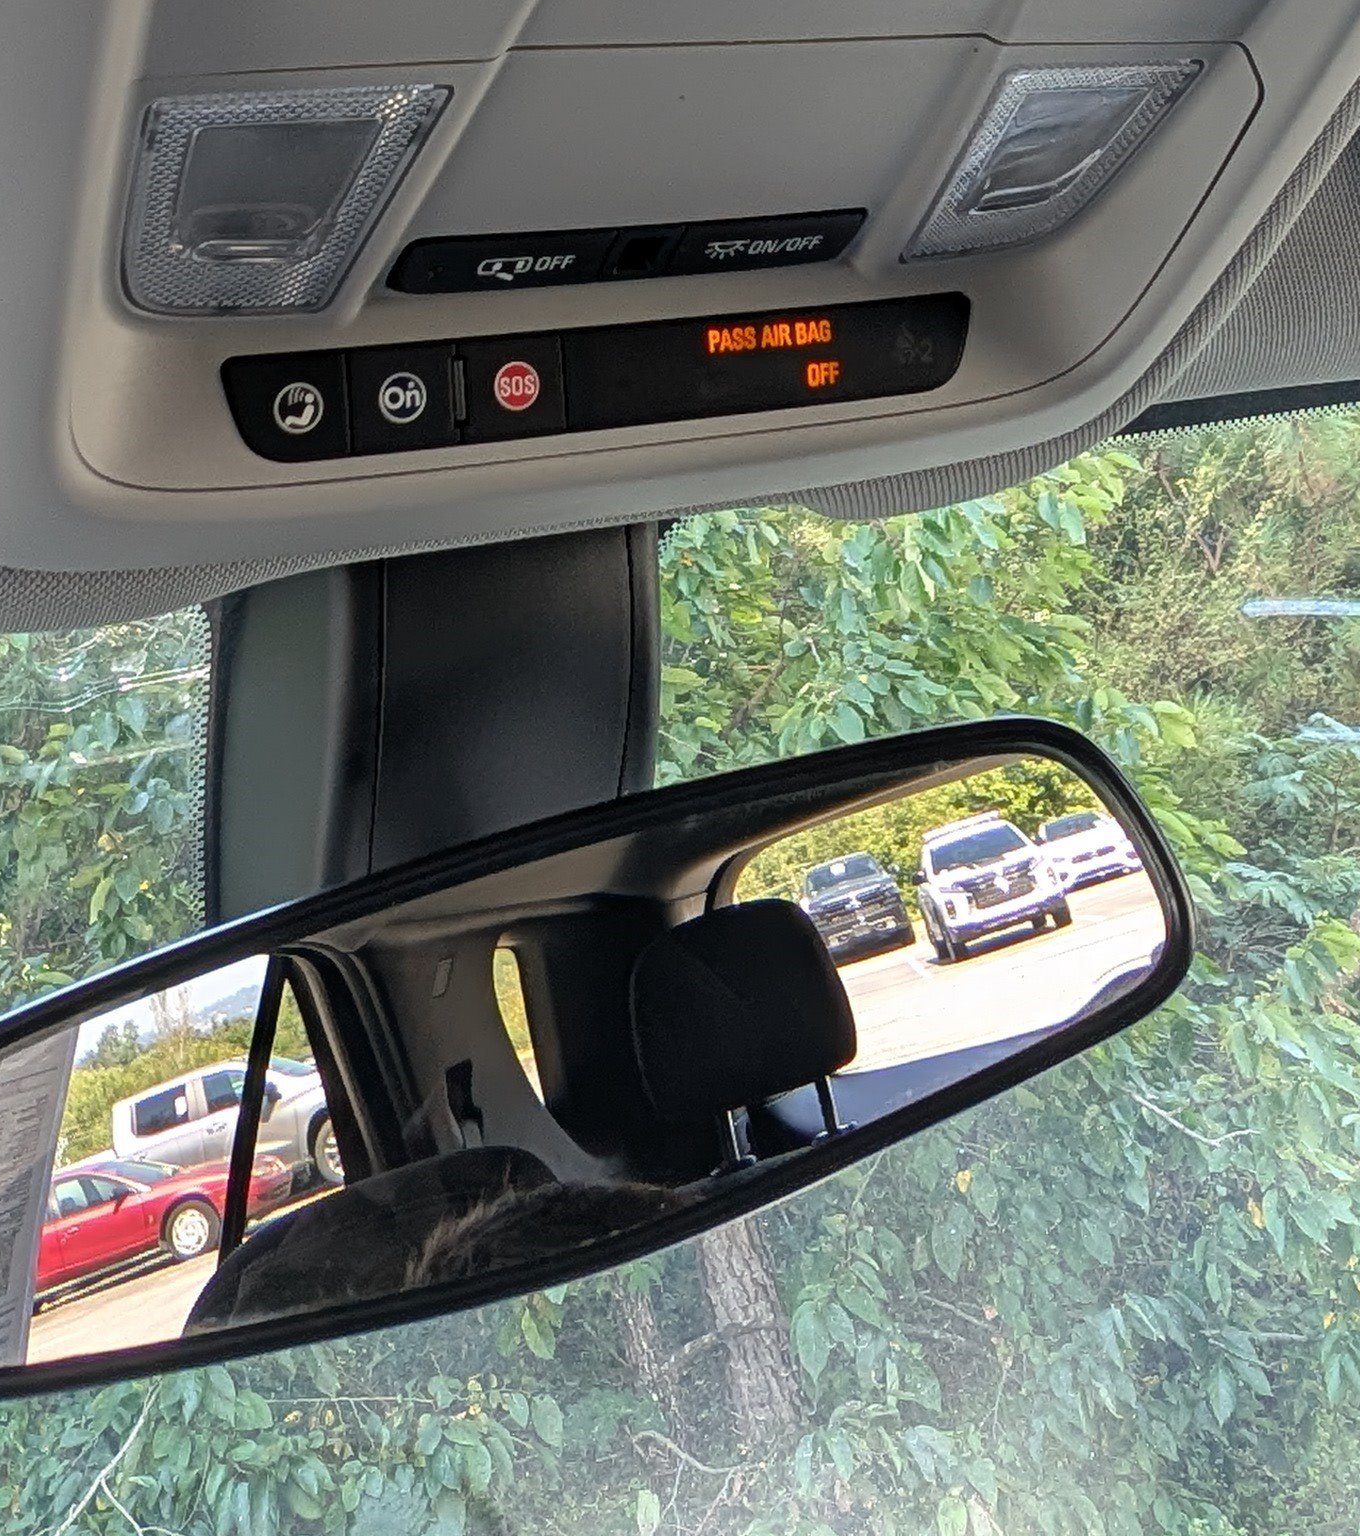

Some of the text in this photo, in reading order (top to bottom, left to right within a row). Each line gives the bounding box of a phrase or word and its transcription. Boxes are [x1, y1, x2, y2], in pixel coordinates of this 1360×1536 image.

[748, 235, 824, 254] ON/OFF
[534, 255, 576, 271] OFF
[707, 320, 832, 354] PASS AIR BAG
[806, 361, 839, 387] OFF
[500, 375, 534, 397] SOS
